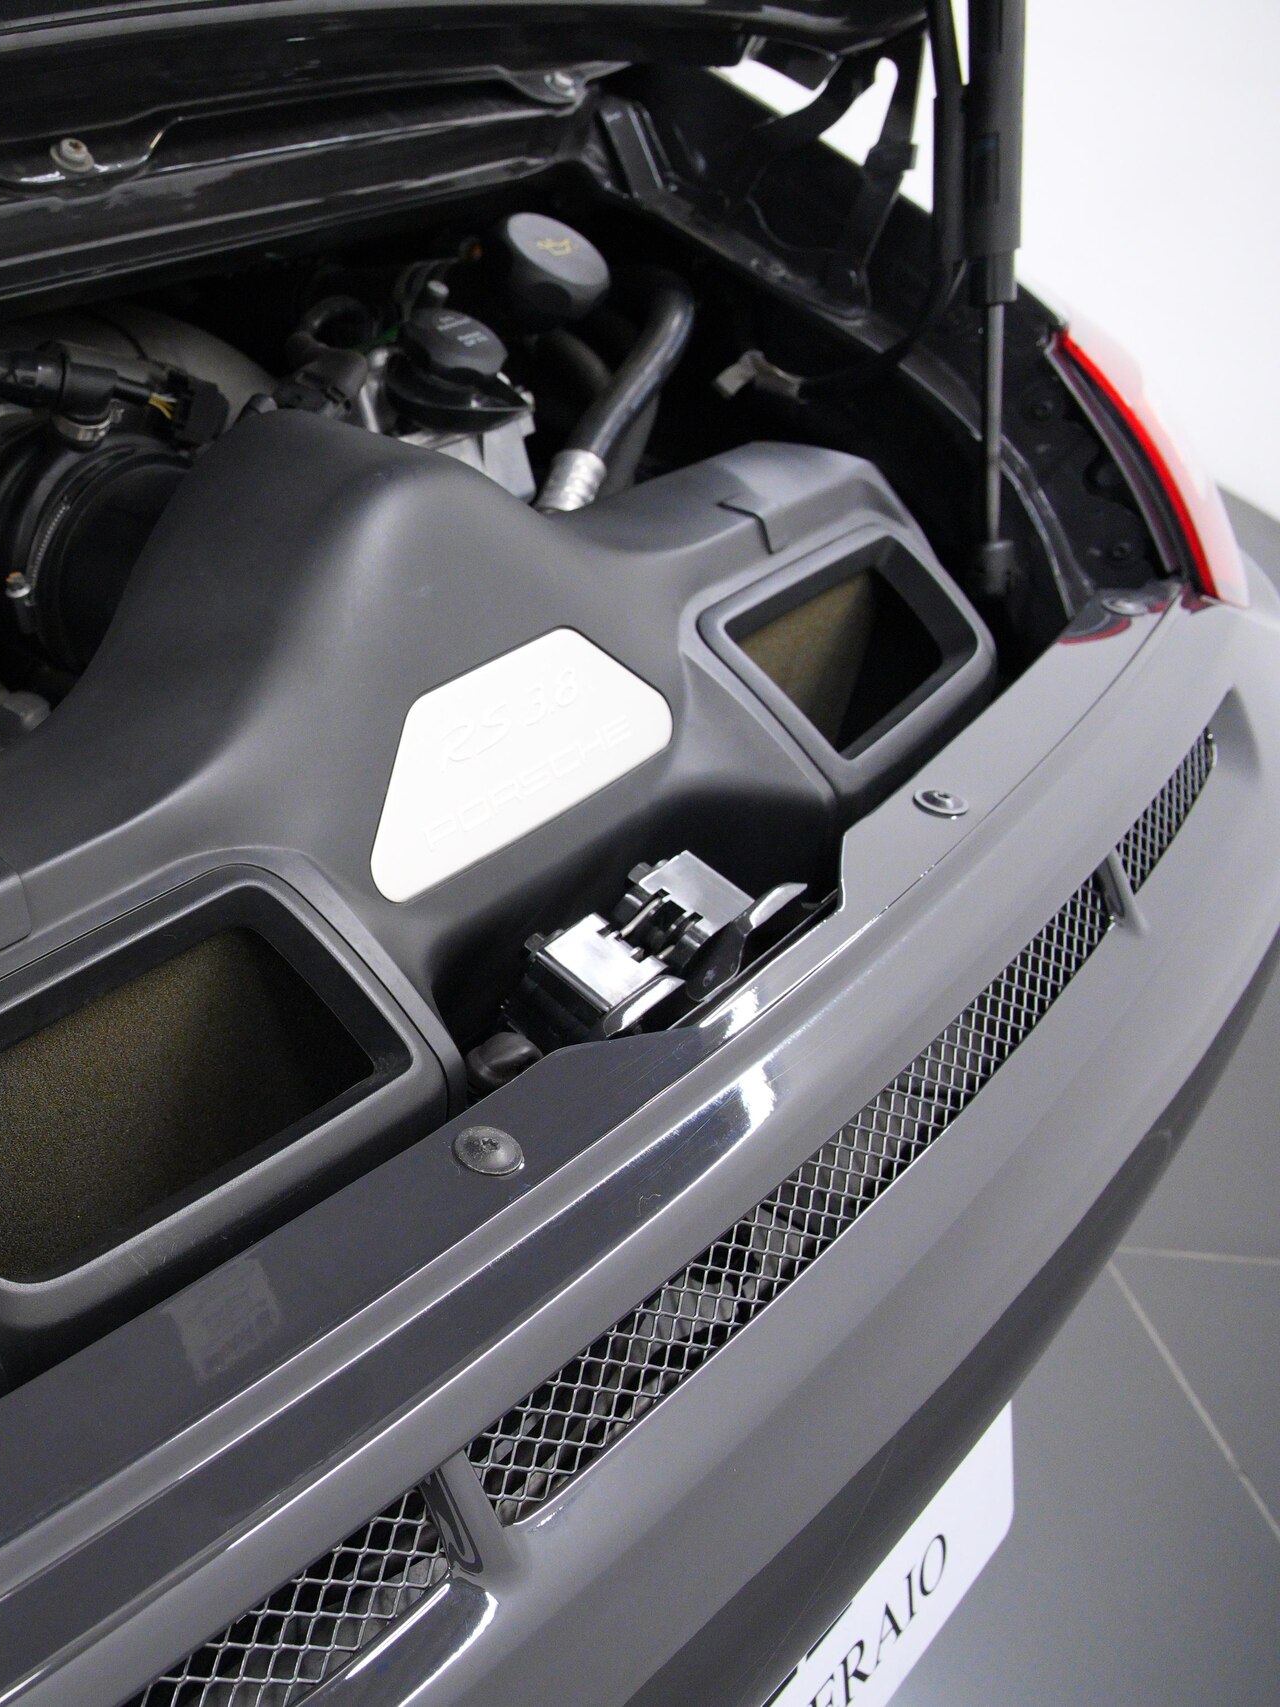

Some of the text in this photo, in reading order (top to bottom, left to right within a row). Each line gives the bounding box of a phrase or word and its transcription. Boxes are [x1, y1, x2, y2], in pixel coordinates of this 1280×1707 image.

[523, 667, 577, 727] 3.8
[422, 714, 634, 852] PORSCHE
[807, 1533, 947, 1707] RAIO
